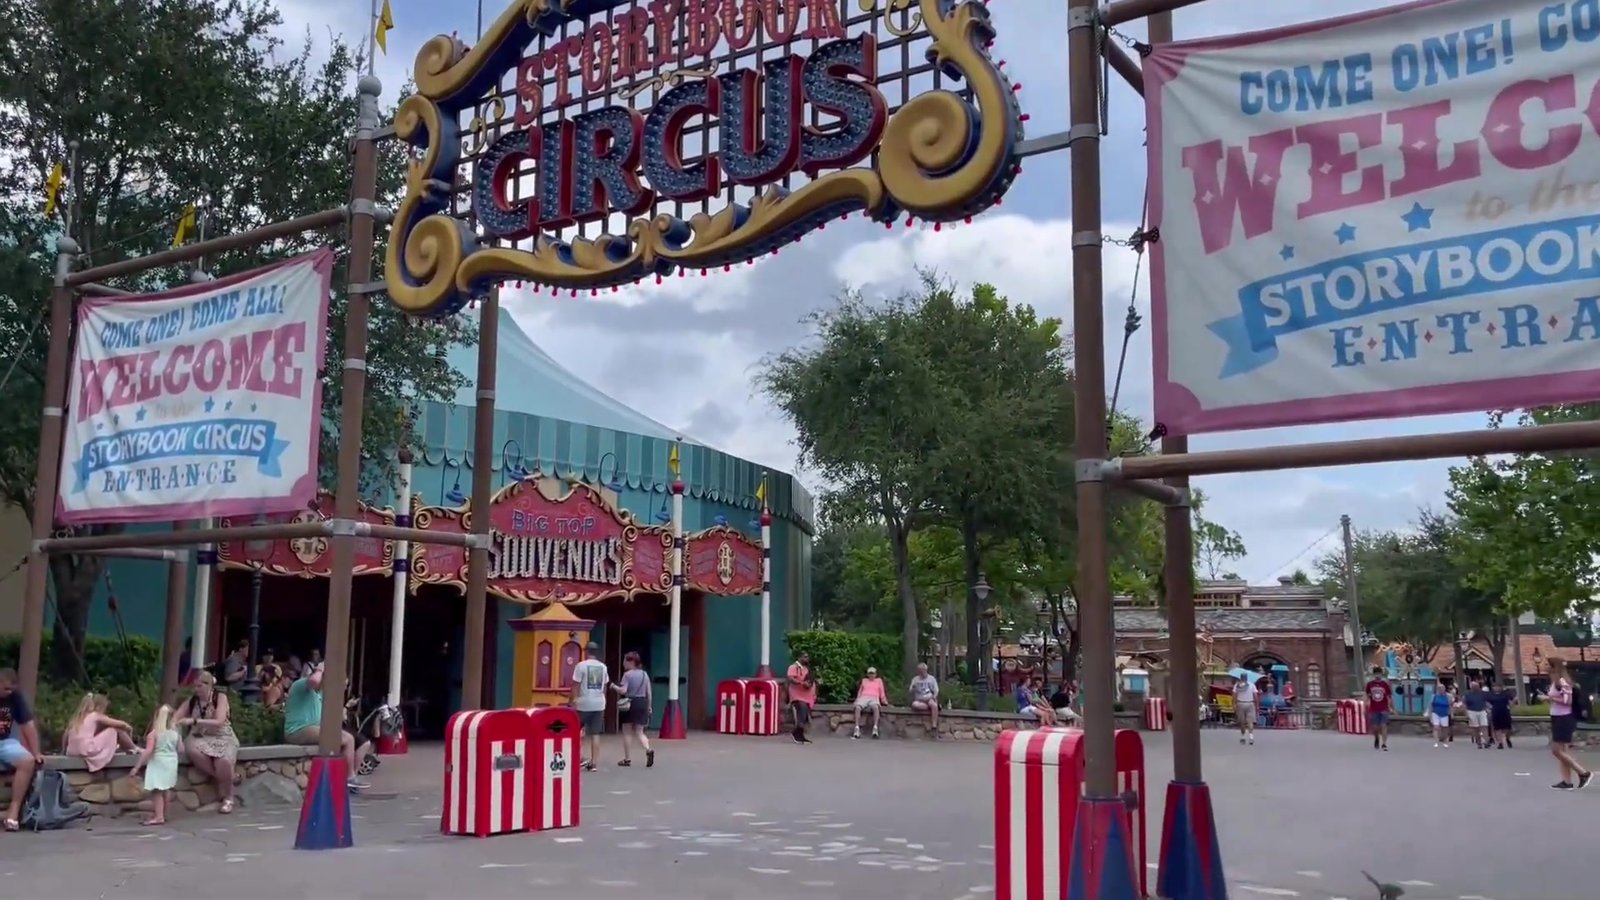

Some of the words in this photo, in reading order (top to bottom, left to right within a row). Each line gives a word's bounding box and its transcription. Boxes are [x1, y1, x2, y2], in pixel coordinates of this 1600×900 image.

[513, 0, 846, 127] STORYBOOK
[1240, 52, 1374, 116] COME
[1391, 18, 1514, 93] ONE!
[474, 32, 887, 241] CIRCUS
[1182, 73, 1600, 256] WELC
[1464, 190, 1512, 221] to
[101, 319, 144, 350] COME
[145, 307, 183, 345] ONE!
[189, 295, 236, 332] COME
[242, 285, 288, 316] ALL!
[1259, 223, 1600, 328] STORYBOOK
[77, 321, 307, 424] WELCOME
[87, 428, 190, 469] STORYBOOK
[192, 423, 267, 451] CIRCUS
[487, 527, 622, 585] SOUVENIRS
[511, 508, 549, 531] BIG
[555, 516, 596, 536] TOP
